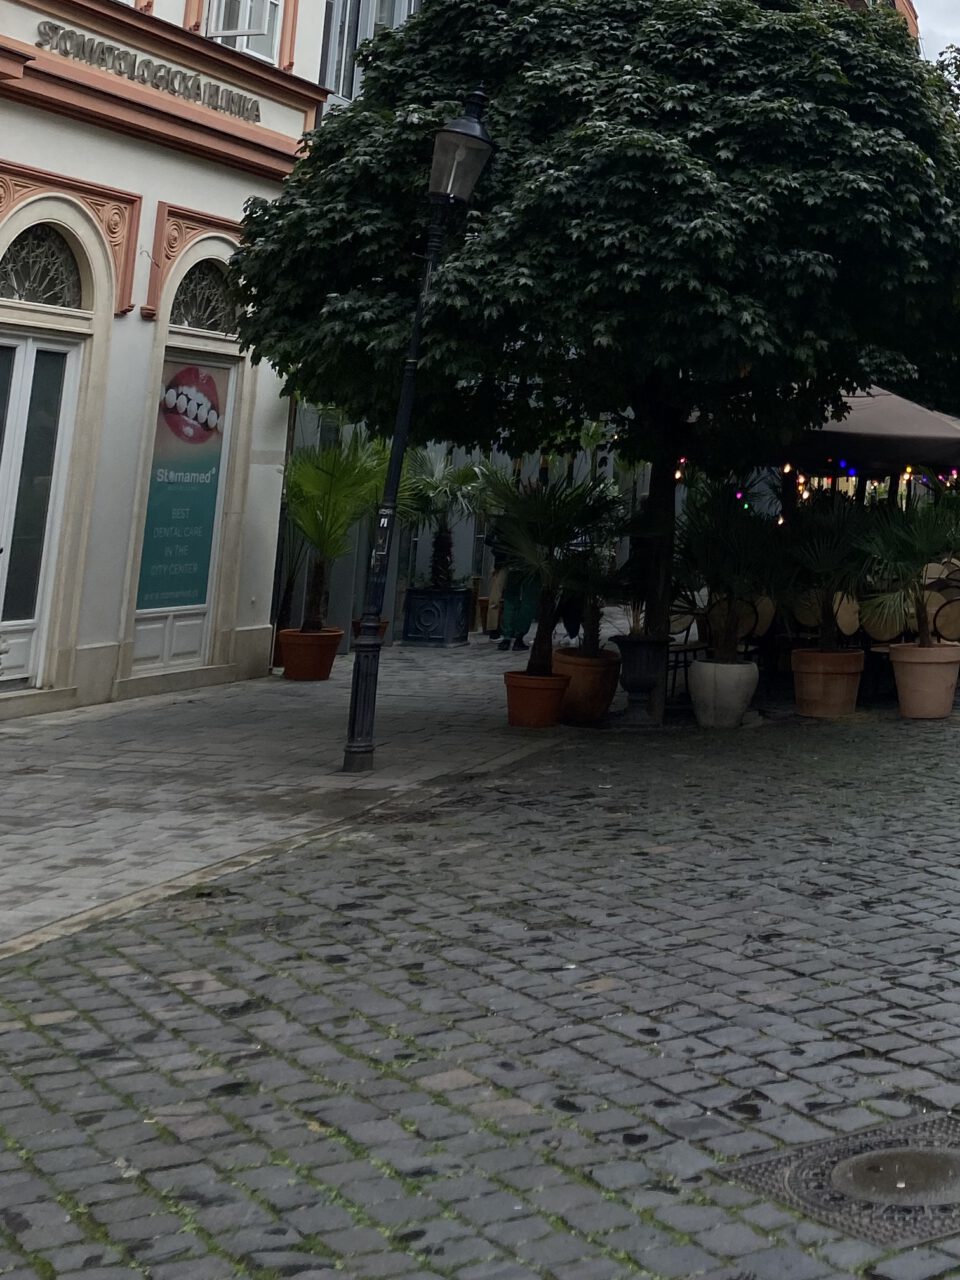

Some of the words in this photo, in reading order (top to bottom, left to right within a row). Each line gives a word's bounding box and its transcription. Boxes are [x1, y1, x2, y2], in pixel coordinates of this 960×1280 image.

[35, 21, 202, 102] STOMATOLOGICKÁ
[203, 81, 261, 123] KLINIKA
[156, 469, 211, 484] Stomamed
[171, 507, 190, 519] BEST
[153, 527, 182, 538] DENTAL
